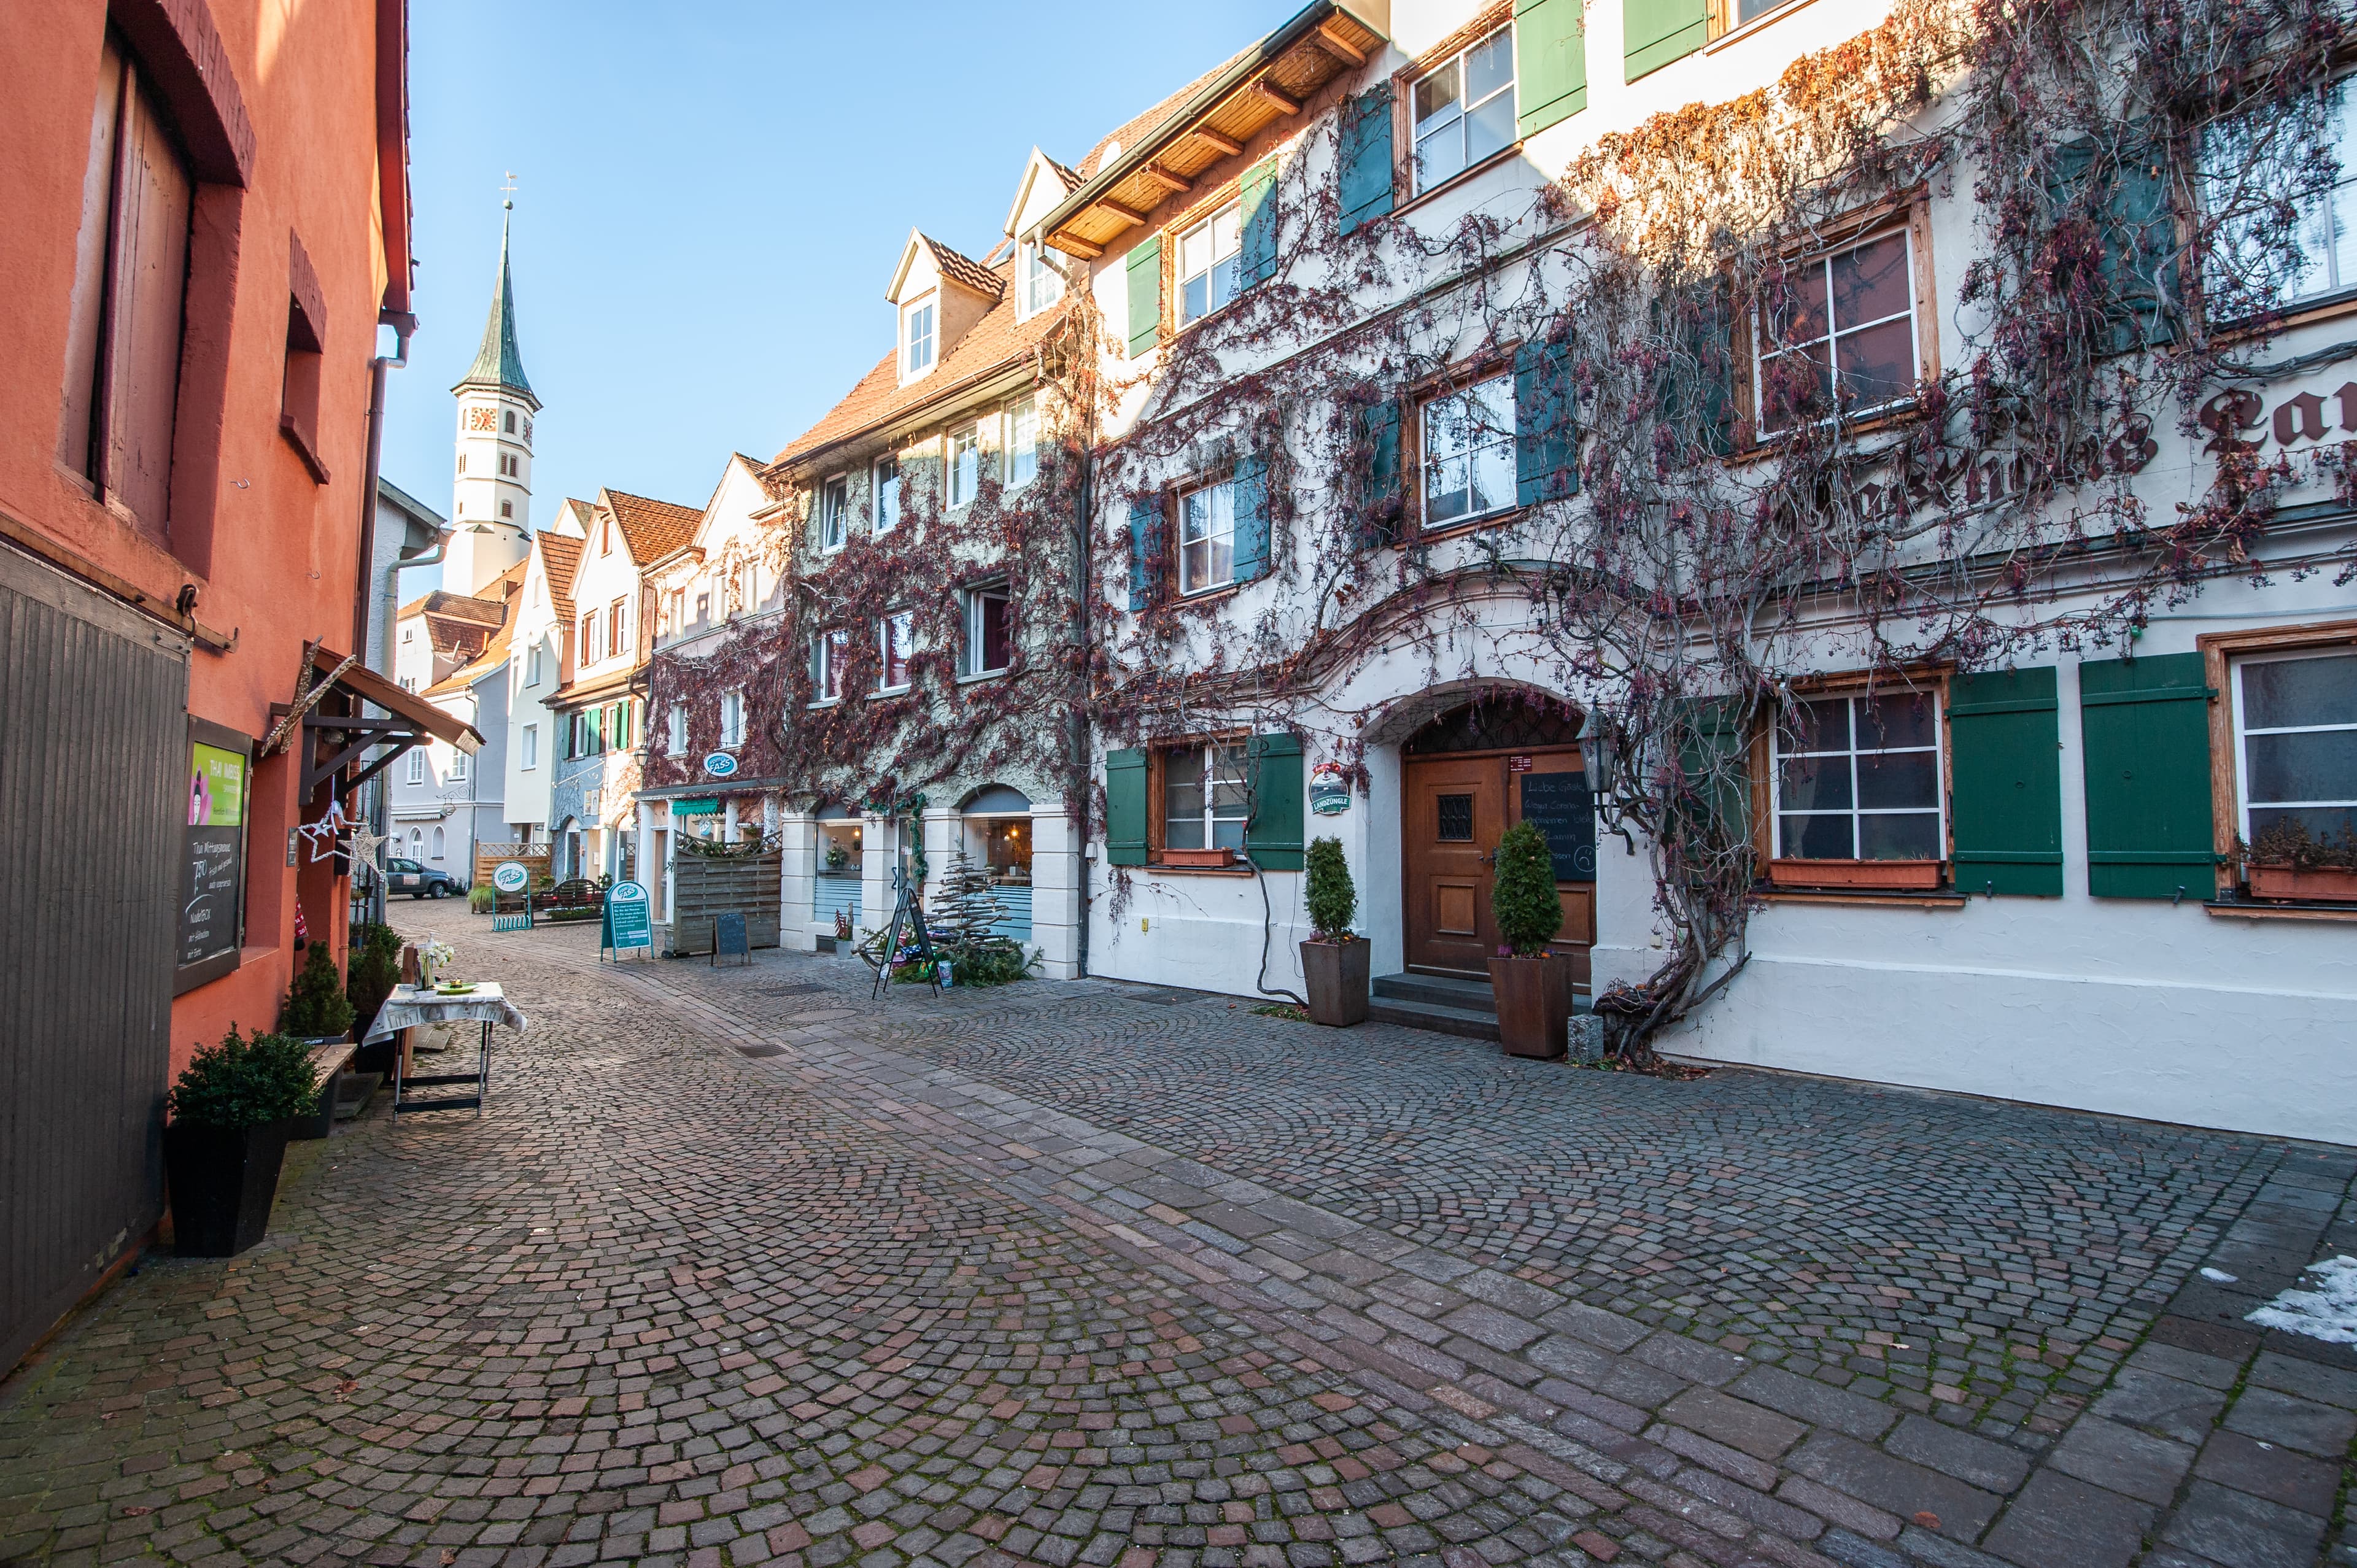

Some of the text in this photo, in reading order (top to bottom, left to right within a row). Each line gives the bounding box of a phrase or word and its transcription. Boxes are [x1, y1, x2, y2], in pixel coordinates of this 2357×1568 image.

[210, 760, 222, 778] THAI
[710, 759, 731, 773] FASS
[1528, 780, 1556, 792] Liebe
[1314, 797, 1348, 810] LANDZÜNGLE
[500, 871, 522, 886] FASS
[620, 886, 636, 900] FASS
